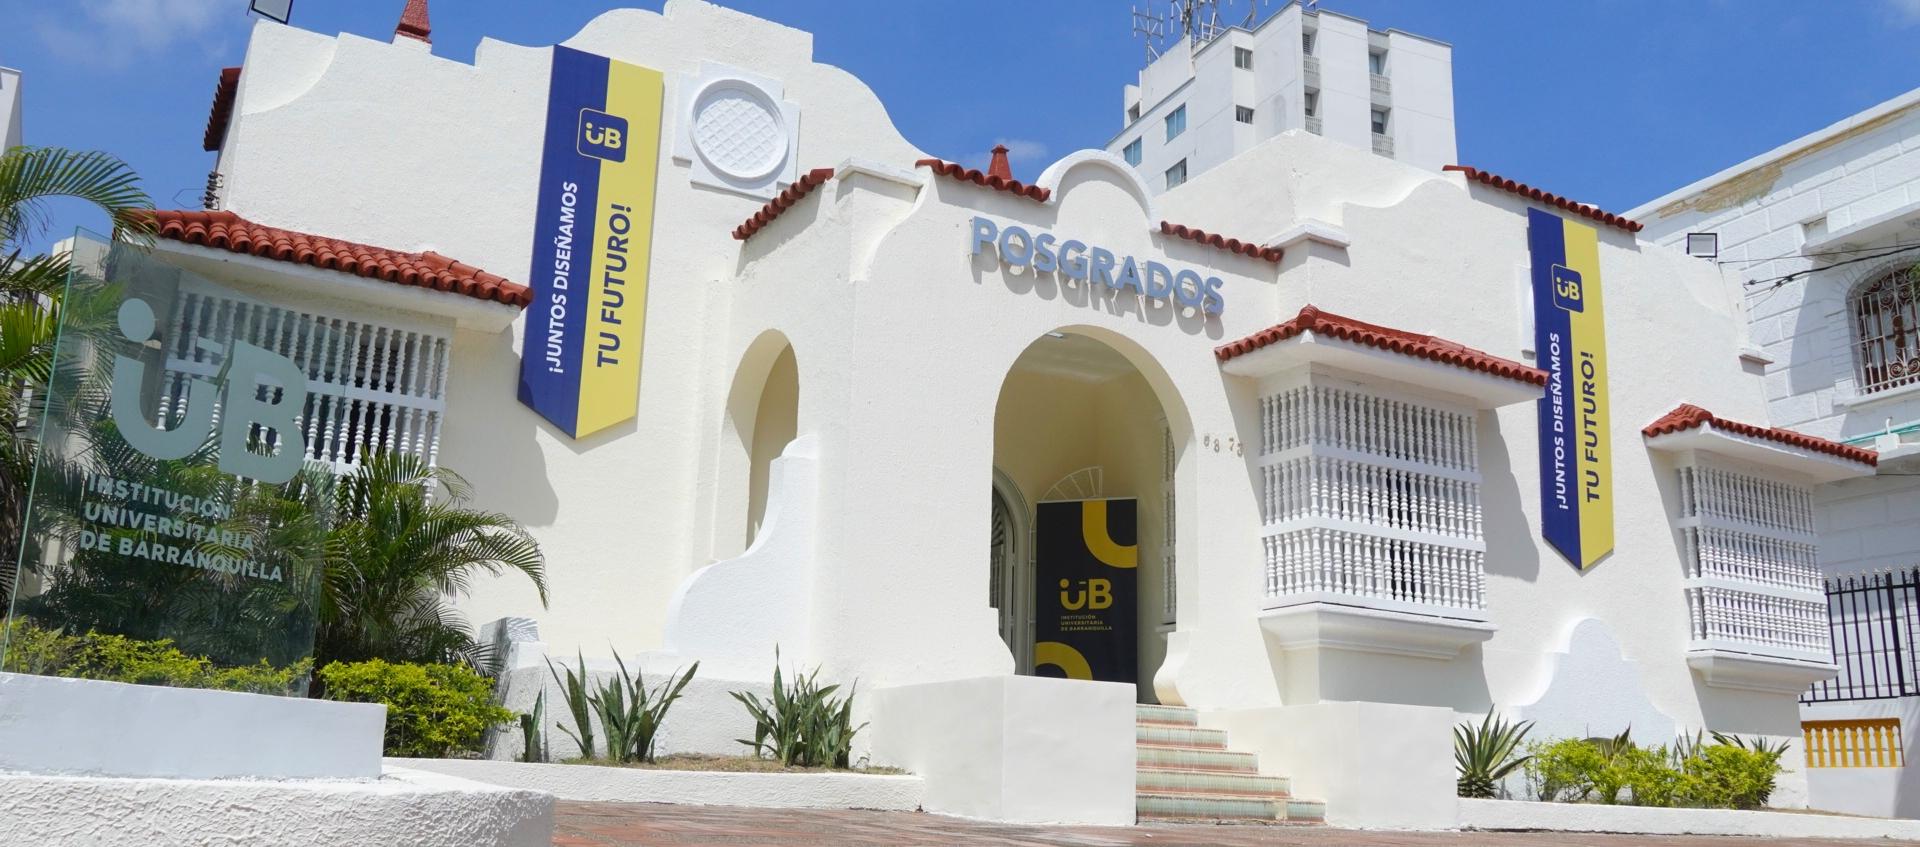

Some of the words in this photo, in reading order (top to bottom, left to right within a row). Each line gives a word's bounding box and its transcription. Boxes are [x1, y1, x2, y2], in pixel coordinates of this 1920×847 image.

[553, 181, 578, 290] DISEÑAMOS
[601, 203, 632, 325] FUTURO!
[972, 215, 1225, 316] POSGRADOS
[546, 293, 567, 373] ¡JUNTOS
[597, 332, 621, 368] TU
[1550, 332, 1564, 433] DISEÑAMOS
[1580, 351, 1599, 463] FUTURO!
[88, 473, 232, 521] INSTITUCIÓN
[1554, 436, 1569, 510] ¡JUNTOS
[1586, 470, 1600, 503] TU
[79, 530, 112, 553] DE
[119, 540, 283, 582] BARRANQUILLA
[84, 501, 254, 550] UNIVERSITARIA
